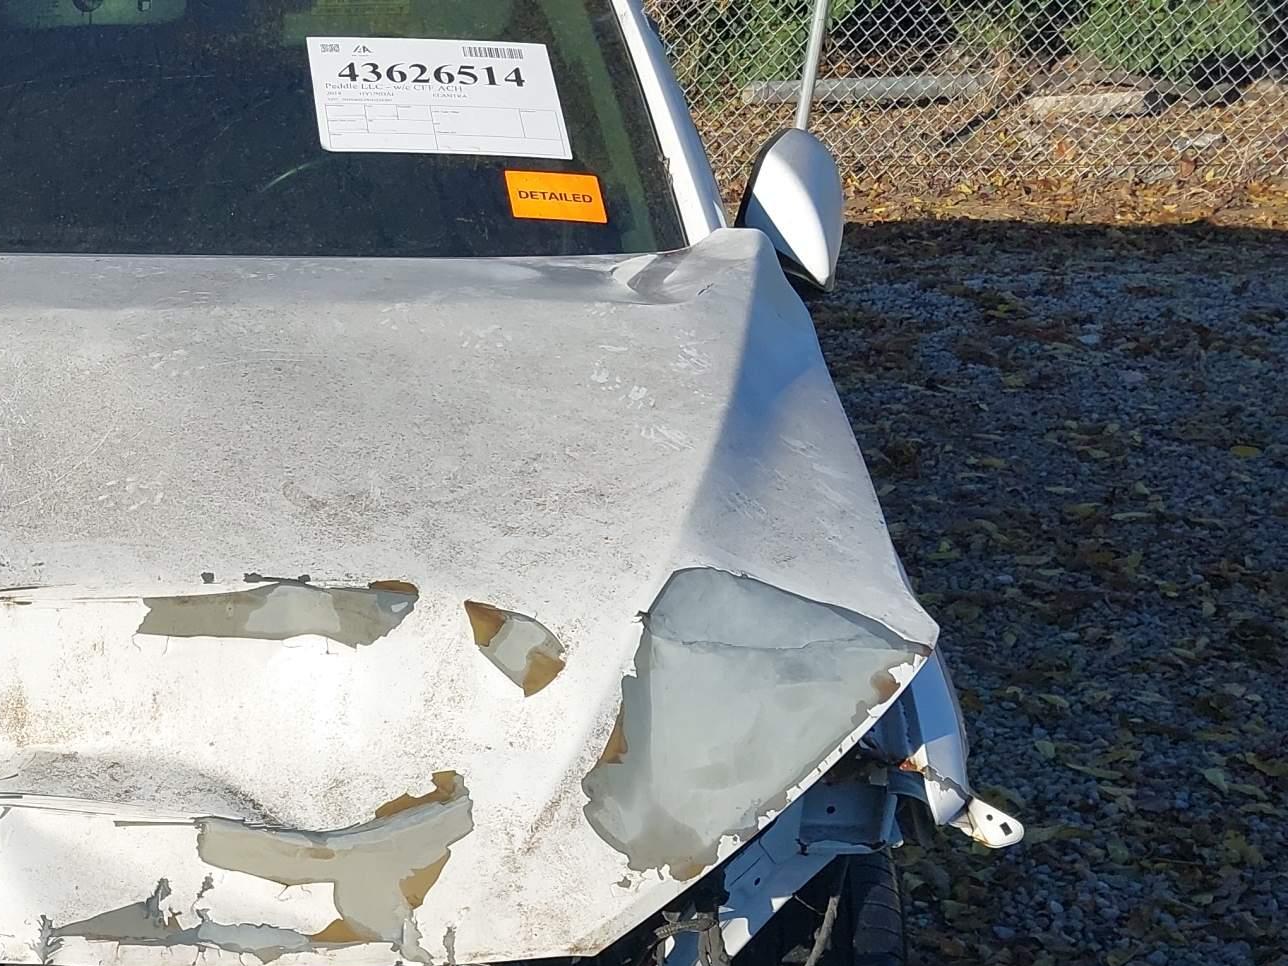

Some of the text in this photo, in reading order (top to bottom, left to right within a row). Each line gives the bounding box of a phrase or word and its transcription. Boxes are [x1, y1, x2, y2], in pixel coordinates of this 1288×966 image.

[337, 61, 526, 87] 43626514
[325, 82, 358, 90] Peddle
[518, 190, 593, 203] DETAILED
